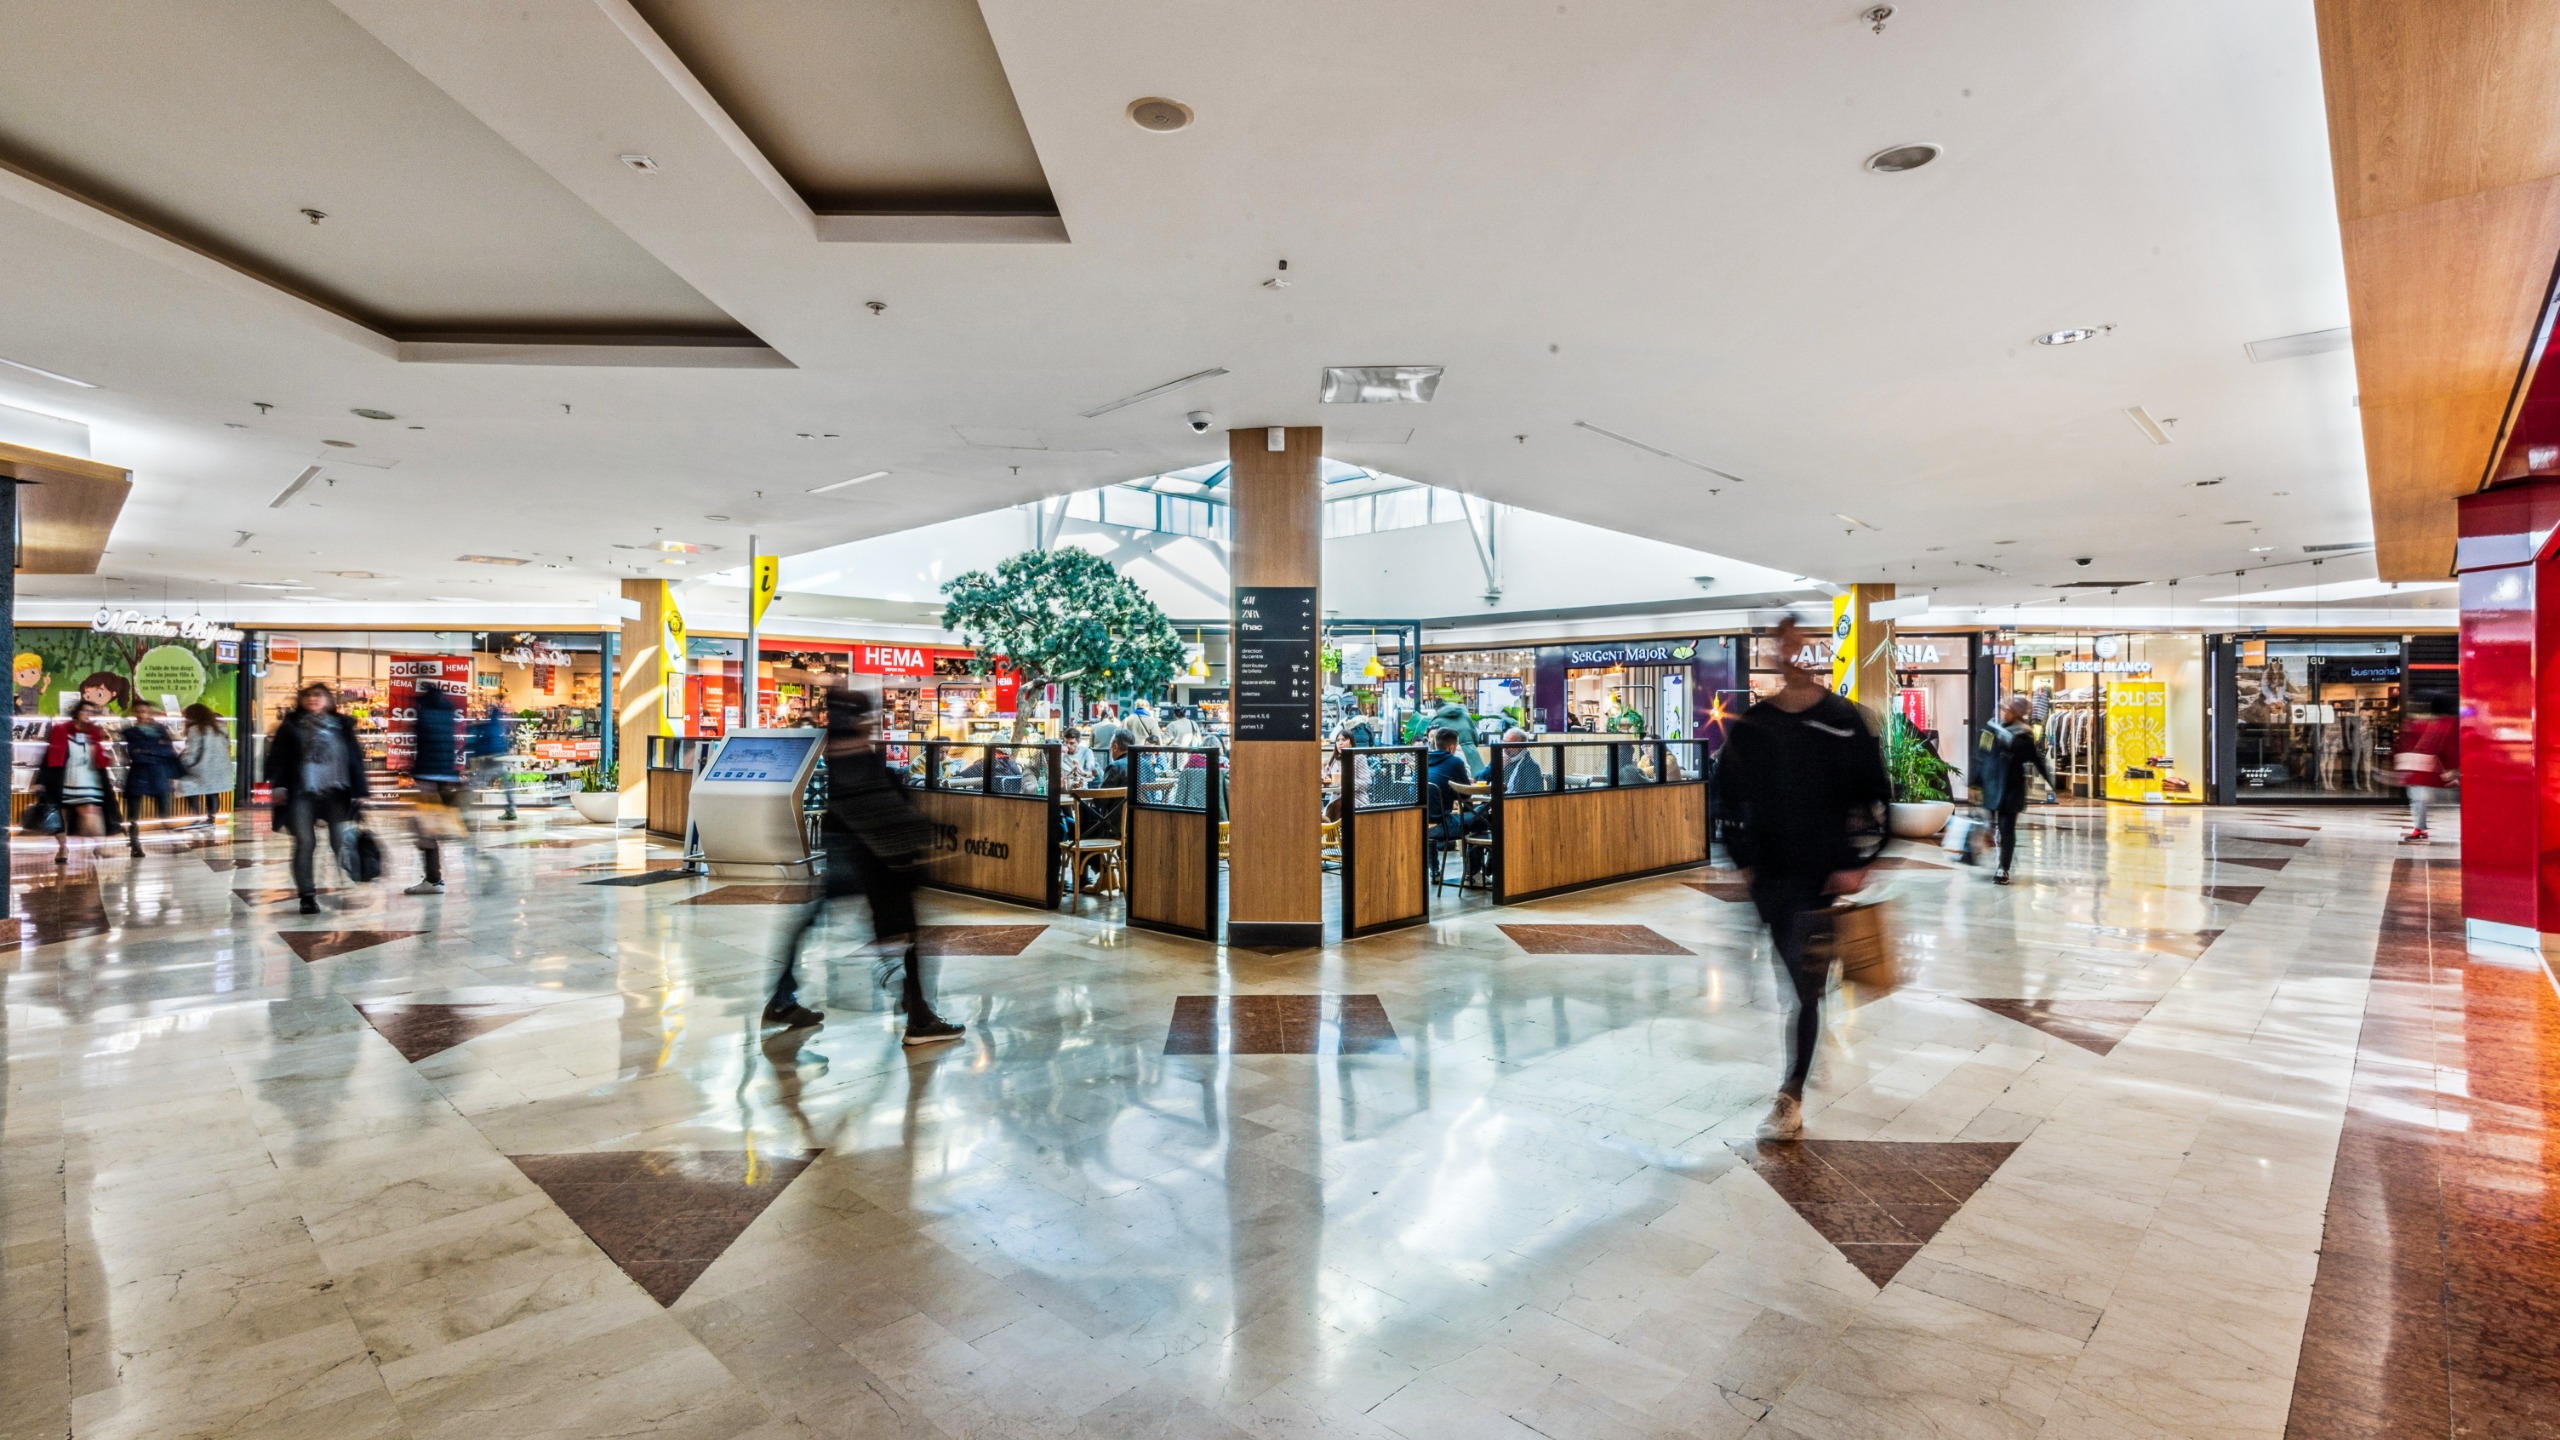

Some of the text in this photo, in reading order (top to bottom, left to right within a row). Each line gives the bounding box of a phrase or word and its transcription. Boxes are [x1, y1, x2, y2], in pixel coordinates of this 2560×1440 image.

[1242, 610, 1260, 618] ZARA
[1242, 622, 1263, 630] fnac
[865, 647, 924, 668] HEMA
[390, 663, 436, 674] soldes
[2063, 662, 2150, 672] SERGE BLANCO
[390, 679, 412, 688] HEMA
[998, 678, 1013, 686] HEMA
[2110, 691, 2164, 706] SOLDES
